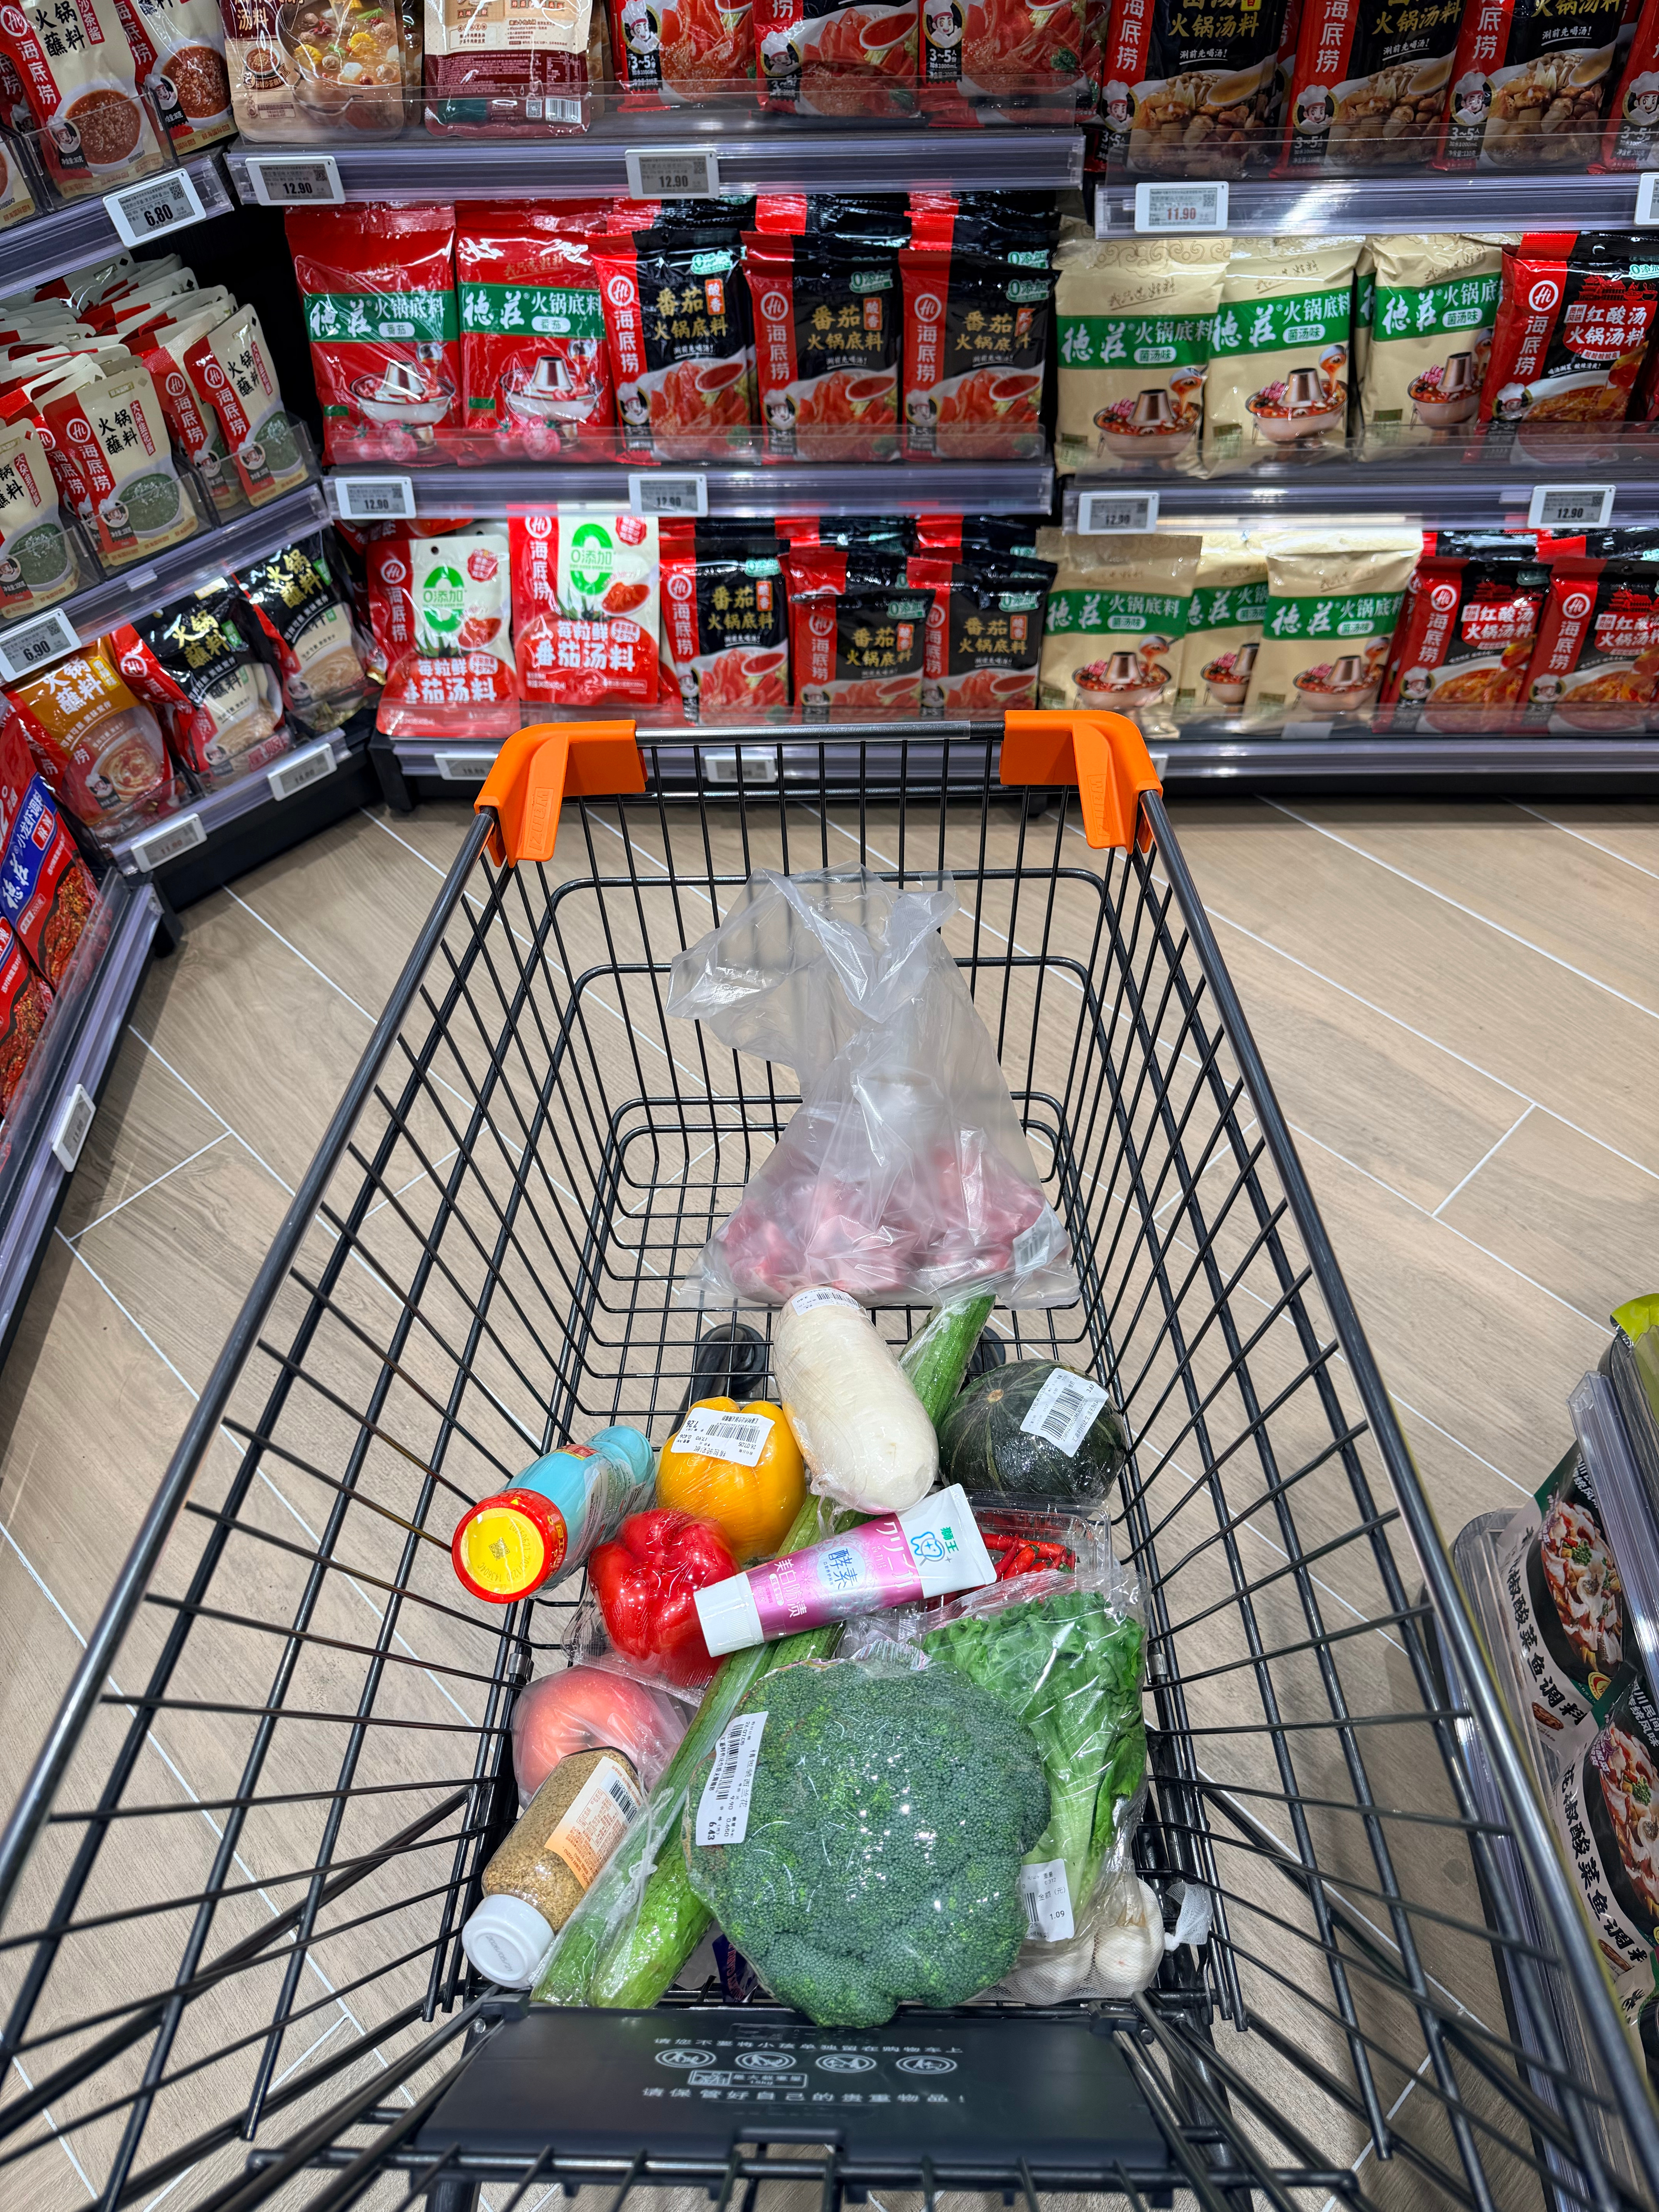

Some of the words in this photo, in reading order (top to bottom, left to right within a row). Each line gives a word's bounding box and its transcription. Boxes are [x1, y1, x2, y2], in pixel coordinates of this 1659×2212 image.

[36, 1, 77, 31] 火锅
[79, 0, 102, 41] 沙茶酱
[237, 7, 268, 31] 汤料
[1168, 12, 1259, 38] 火锅汤料
[1372, 5, 1461, 34] 火锅汤料
[44, 25, 85, 57] 蘸料
[114, 1, 152, 65] 海底捞
[1116, 0, 1144, 71] 海底捞
[1316, 0, 1349, 73] 海底捞
[1473, 0, 1504, 59] 底捞
[1542, 26, 1591, 39] 涮前先喝汤!
[15, 39, 56, 104] 海底捞
[283, 182, 313, 194] 12.90
[659, 175, 688, 188] 12.90
[144, 204, 173, 226] 6.80
[1166, 208, 1196, 220] 11.90
[374, 296, 445, 320] 火锅底料
[531, 292, 603, 316] 火锅底料
[656, 287, 703, 316] 番茄
[708, 283, 723, 312] 酸香
[1283, 292, 1350, 325] 火锅底料
[539, 319, 561, 330] 番茄
[654, 316, 728, 340] 火锅底料
[812, 305, 860, 330] 番茄
[964, 311, 1013, 334] 番茄
[1446, 311, 1479, 325] 菌汤味
[1587, 305, 1647, 326] 红酸汤
[387, 324, 407, 335] 番茄
[614, 310, 639, 373] 海底捞
[807, 331, 883, 351] 火锅底料
[1135, 319, 1213, 345] 火锅底料
[1288, 328, 1322, 341] 菌汤味
[1568, 327, 1645, 347] 火锅汤料
[767, 325, 789, 381] 海底捞
[917, 326, 938, 382] 海底捞
[1139, 350, 1172, 361] 菌汤味
[1514, 315, 1549, 375] 海底捞
[228, 350, 254, 379] 火锅
[98, 409, 132, 436] 火锅
[174, 396, 206, 444] 海底捞
[215, 388, 247, 436] 海底捞
[106, 429, 137, 455] 蘸料
[78, 443, 111, 492] 海底捞
[364, 500, 389, 510] 12.90
[1558, 508, 1583, 518] 12.90
[267, 549, 311, 582] 火锅
[571, 550, 612, 564] 0添加
[529, 541, 551, 601] 海底捞
[279, 569, 323, 608] 蘸料
[423, 589, 464, 603] 0添加
[711, 586, 754, 611] 番茄
[386, 588, 407, 642] 海底捞
[1108, 593, 1180, 618] 火锅底料
[1480, 606, 1534, 623] 红酸汤
[172, 611, 219, 647] 火锅
[557, 621, 608, 641] 每粒鲜
[672, 603, 693, 656] 海底捞
[707, 613, 775, 630] 火锅底料
[963, 618, 1007, 636] 番茄
[1466, 623, 1532, 639] 火锅汤料
[185, 630, 229, 668] 蘸料
[852, 628, 895, 648] 番茄
[958, 637, 1027, 655] 火锅底料
[1419, 613, 1449, 663] 海底捞
[1549, 621, 1581, 670] 海底捞
[24, 641, 50, 662] 6.90
[536, 641, 635, 671] 番茄汤料
[811, 638, 830, 680] 海底捞
[845, 649, 912, 667] 火锅底料
[418, 660, 467, 677] 每粒鲜
[56, 673, 105, 716] 蘸料
[404, 678, 496, 704] 番茄汤料
[15, 789, 47, 849] 小龙虾调料
[1086, 1383, 1095, 1393] 3.63
[874, 1520, 917, 1590] クリニカ
[827, 1547, 860, 1591] 酵素
[774, 1558, 808, 1618] 美白防渍
[739, 1749, 757, 1807] 精包装西兰花
[707, 1822, 716, 1841] 6.43
[1050, 1910, 1065, 1920] 1.09
[486, 1936, 514, 1972] 2026/05/21
[654, 2038, 963, 2053] 请您不要将小孩单独留在购物车上
